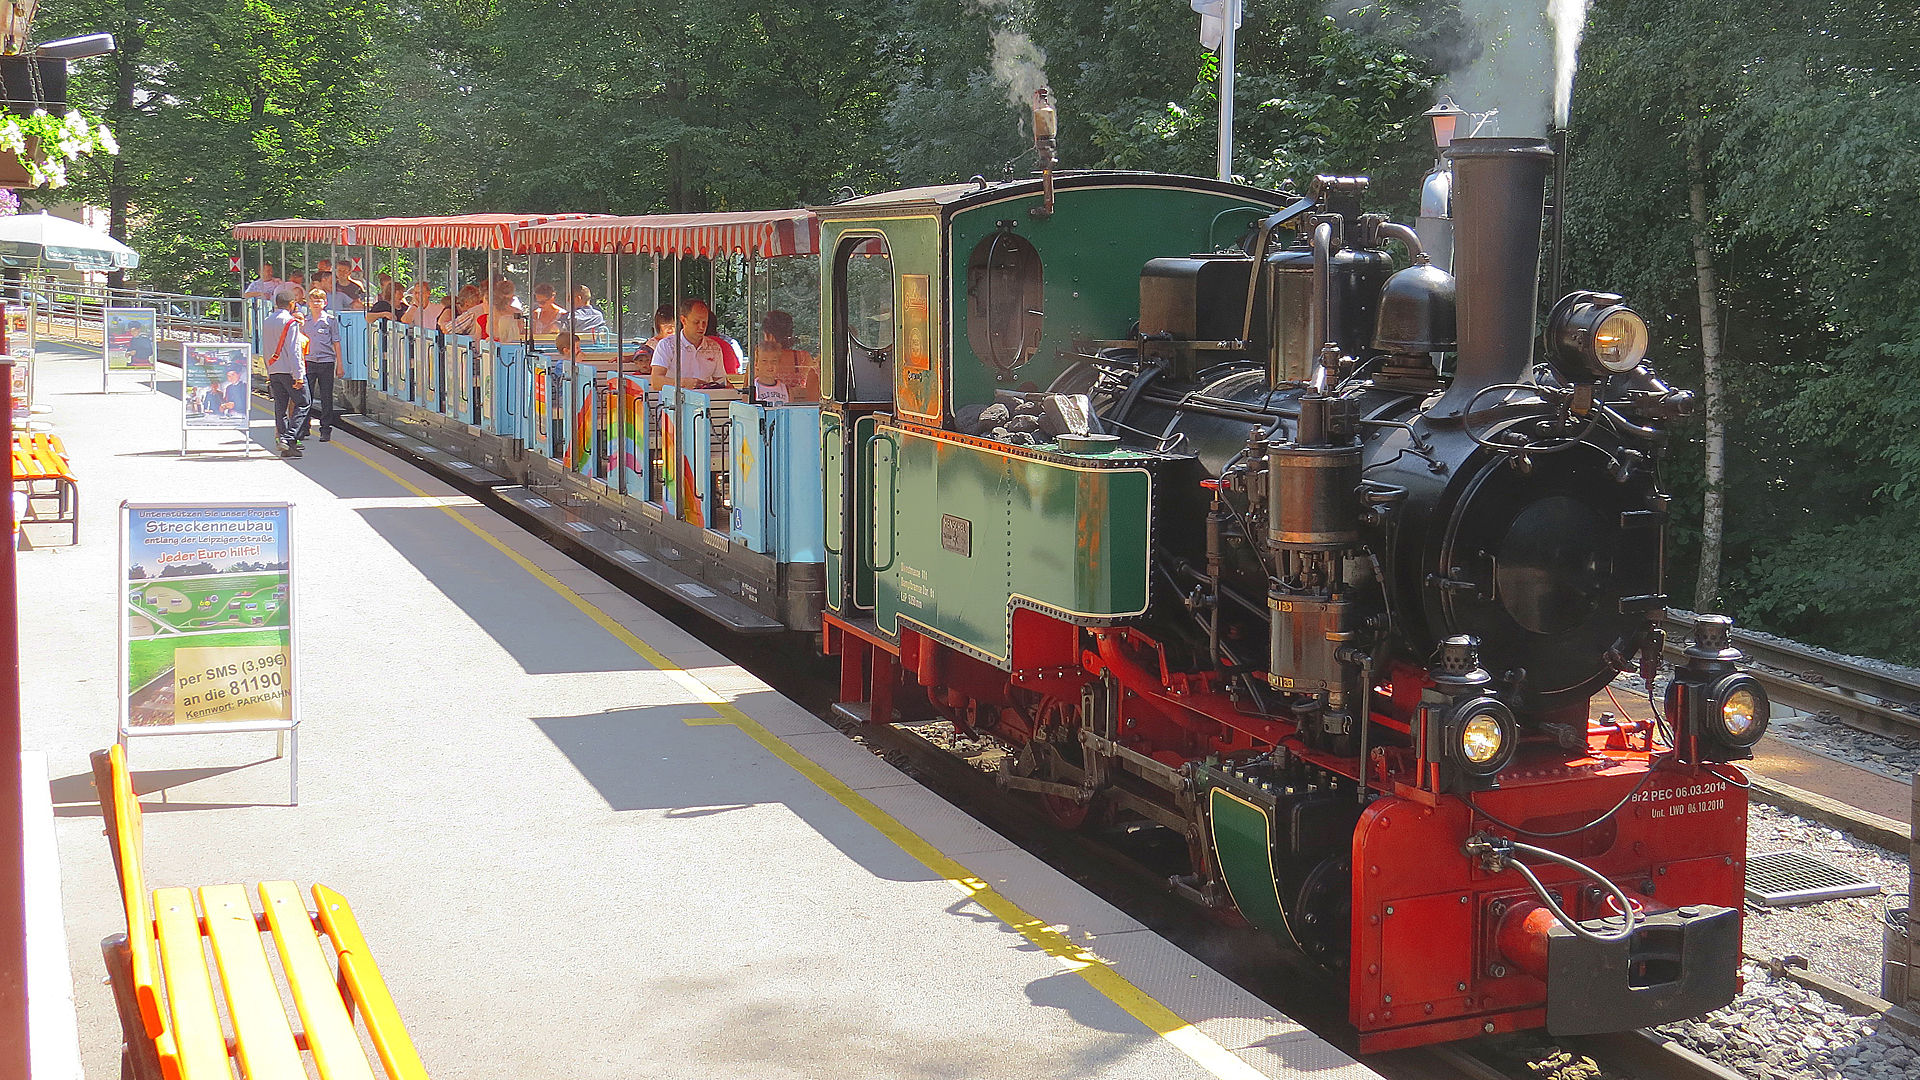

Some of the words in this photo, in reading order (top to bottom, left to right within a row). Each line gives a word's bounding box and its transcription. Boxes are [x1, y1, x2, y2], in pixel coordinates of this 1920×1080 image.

[247, 509, 280, 519] Projekt
[146, 520, 273, 533] Streckenneubau
[144, 536, 179, 545] entlang
[180, 535, 196, 543] der
[198, 535, 238, 545] Leipziger
[157, 552, 195, 564] Jeder
[198, 549, 227, 560] Euro
[230, 546, 261, 557] hilft!
[179, 673, 202, 689] per
[205, 664, 238, 681] SMS
[242, 653, 287, 675] (3,99€)
[183, 694, 201, 707] an
[204, 688, 226, 702] die
[229, 671, 282, 696] 81190
[185, 702, 235, 719] Kennwort:
[237, 689, 292, 708] PARKBAHN
[1651, 788, 1673, 802] PEC
[1675, 781, 1727, 799] 06.03.2014
[1687, 799, 1724, 814] 06.10.2010
